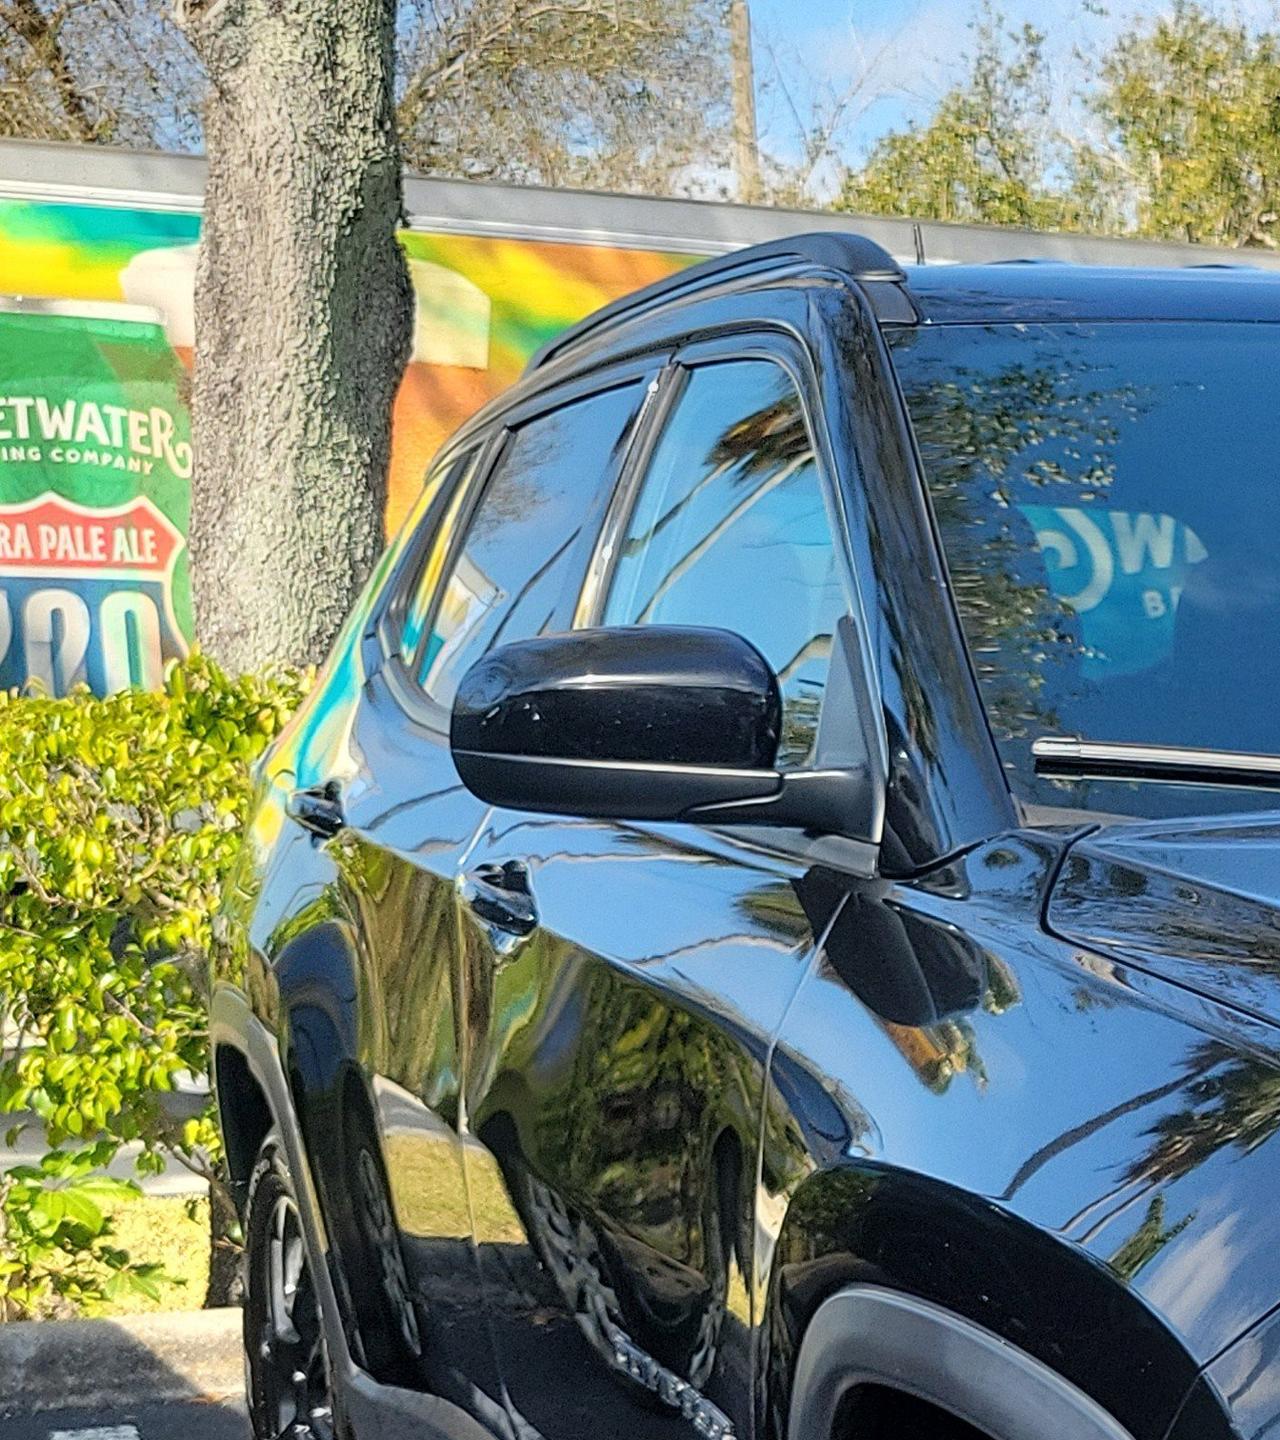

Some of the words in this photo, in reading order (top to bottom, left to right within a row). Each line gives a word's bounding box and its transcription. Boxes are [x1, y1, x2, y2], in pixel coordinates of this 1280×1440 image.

[51, 447, 153, 475] COMPANY
[38, 524, 107, 562] PALE
[112, 527, 158, 564] ALE
[0, 588, 164, 698] 20
